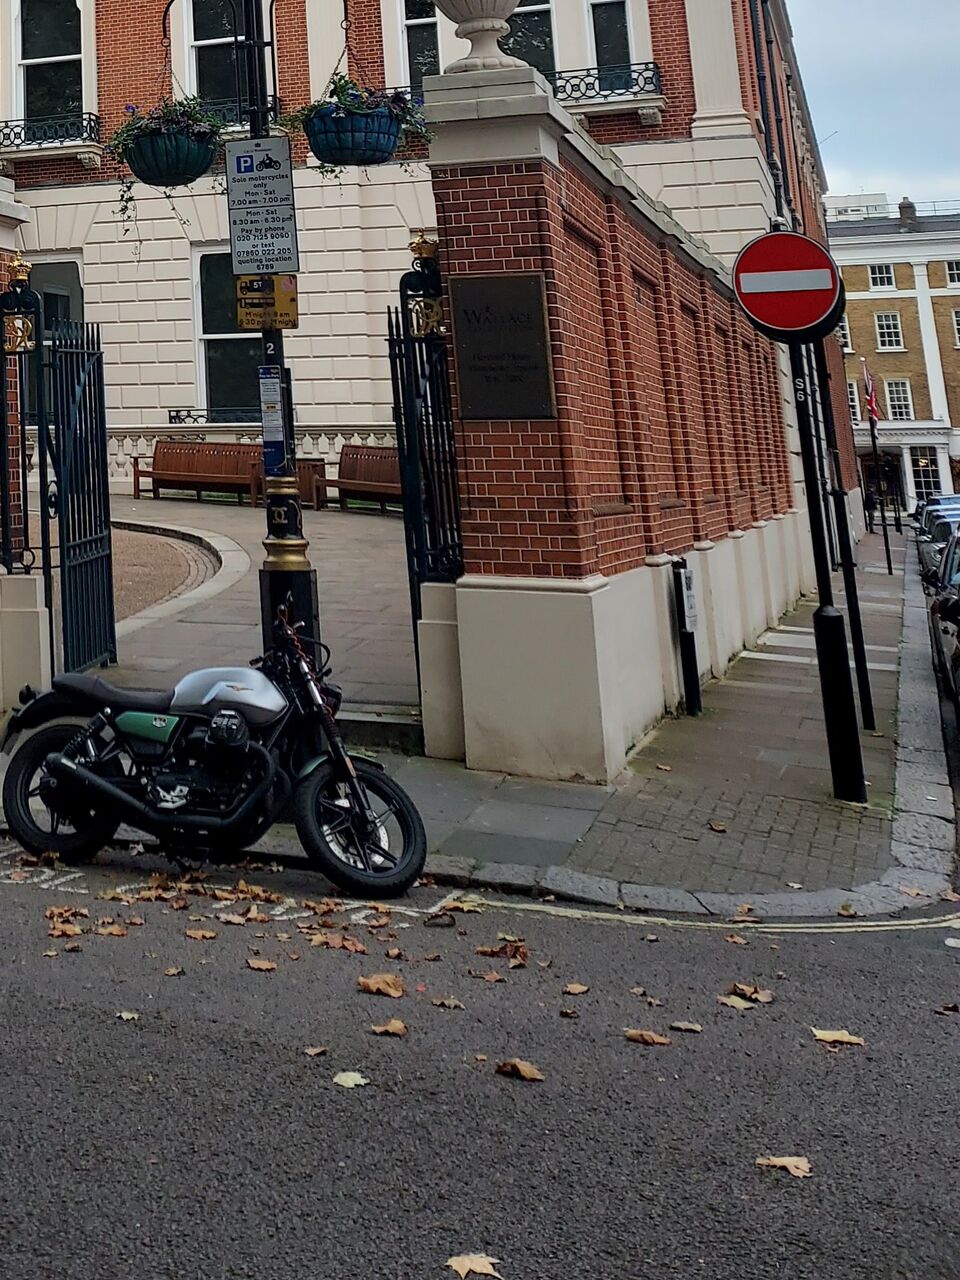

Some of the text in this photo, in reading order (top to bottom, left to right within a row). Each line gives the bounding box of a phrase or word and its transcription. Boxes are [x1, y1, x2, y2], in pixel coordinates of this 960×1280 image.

[248, 173, 289, 182] motorcycles
[240, 227, 253, 235] Pay
[236, 234, 251, 242] 020
[261, 248, 275, 256] 022
[237, 255, 293, 266] quoting location
[253, 281, 263, 289] 5T
[266, 342, 275, 354] 2
[795, 378, 805, 389] S
[796, 391, 805, 401] 6
